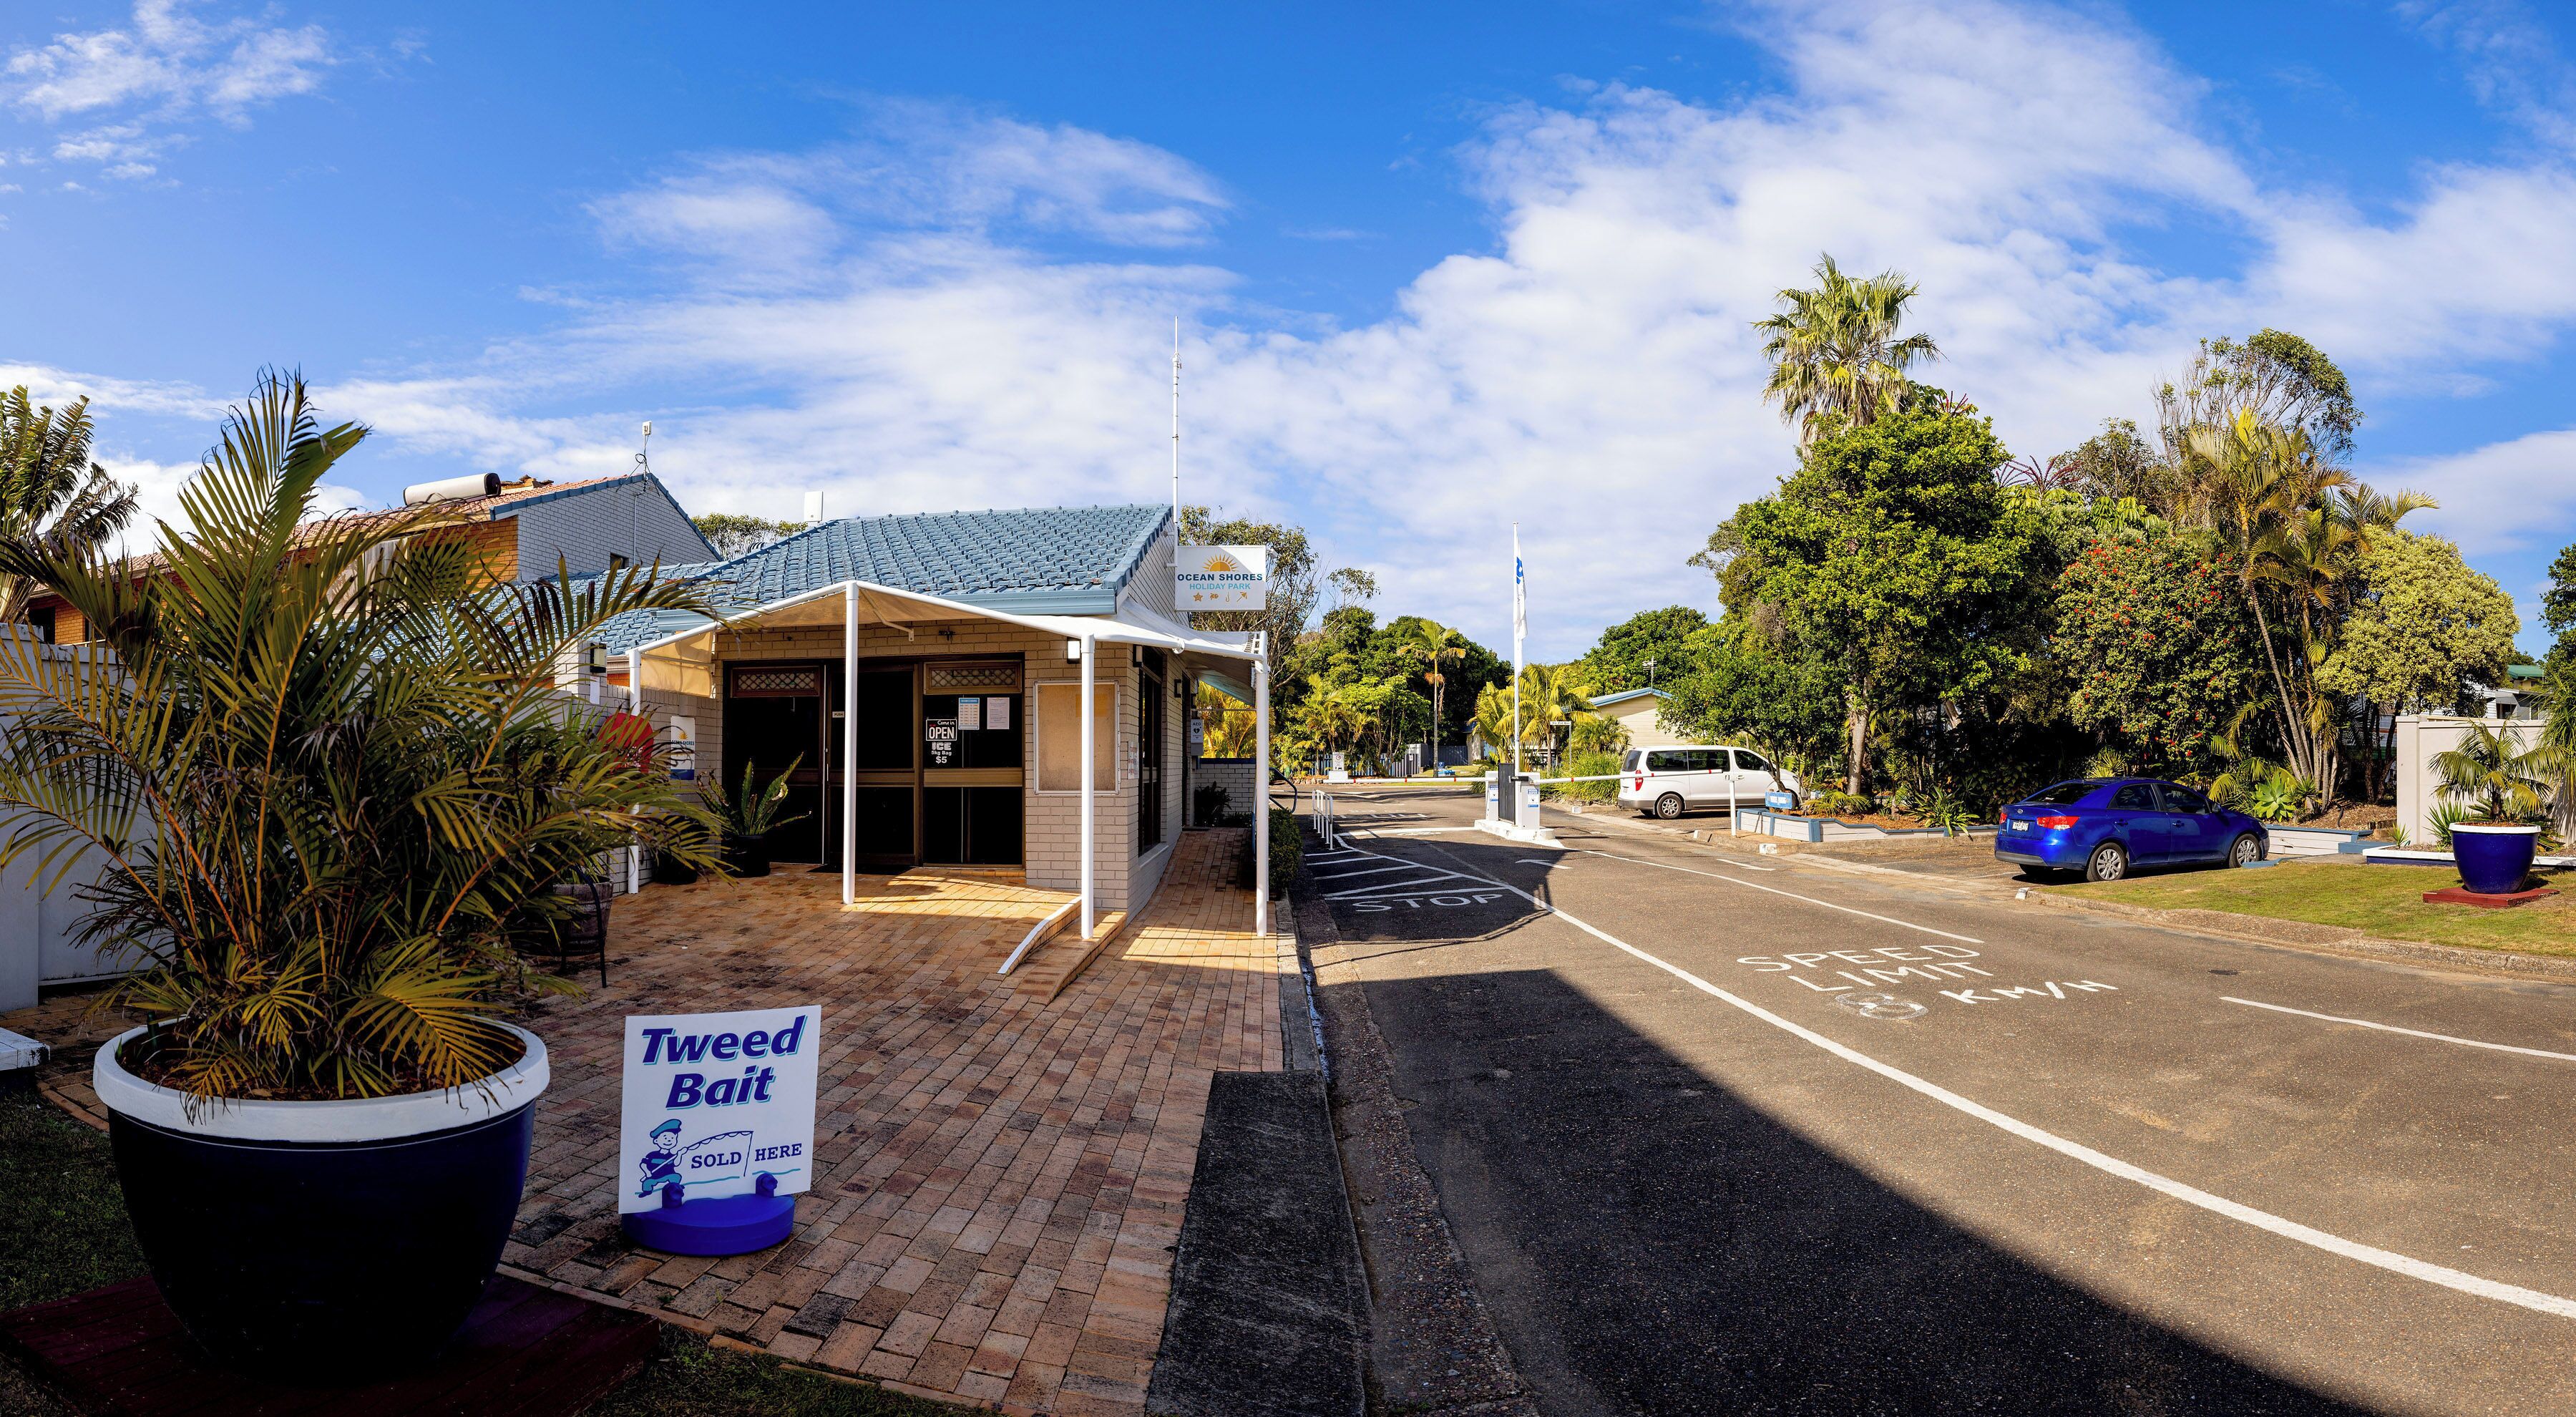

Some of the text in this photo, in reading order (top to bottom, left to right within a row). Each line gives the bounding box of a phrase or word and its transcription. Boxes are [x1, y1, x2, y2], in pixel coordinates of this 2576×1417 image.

[929, 726, 955, 739] OPEN
[932, 741, 952, 751] ICE
[935, 756, 947, 764] $5
[1352, 894, 1503, 912] STOP
[1737, 945, 1981, 972] SPEED
[1787, 962, 1994, 991] LIMIT
[1939, 980, 2119, 1004] KM/H
[641, 1014, 809, 1066] Tweed
[665, 1065, 776, 1111] Bait
[691, 1143, 803, 1169] SOLD HERE
